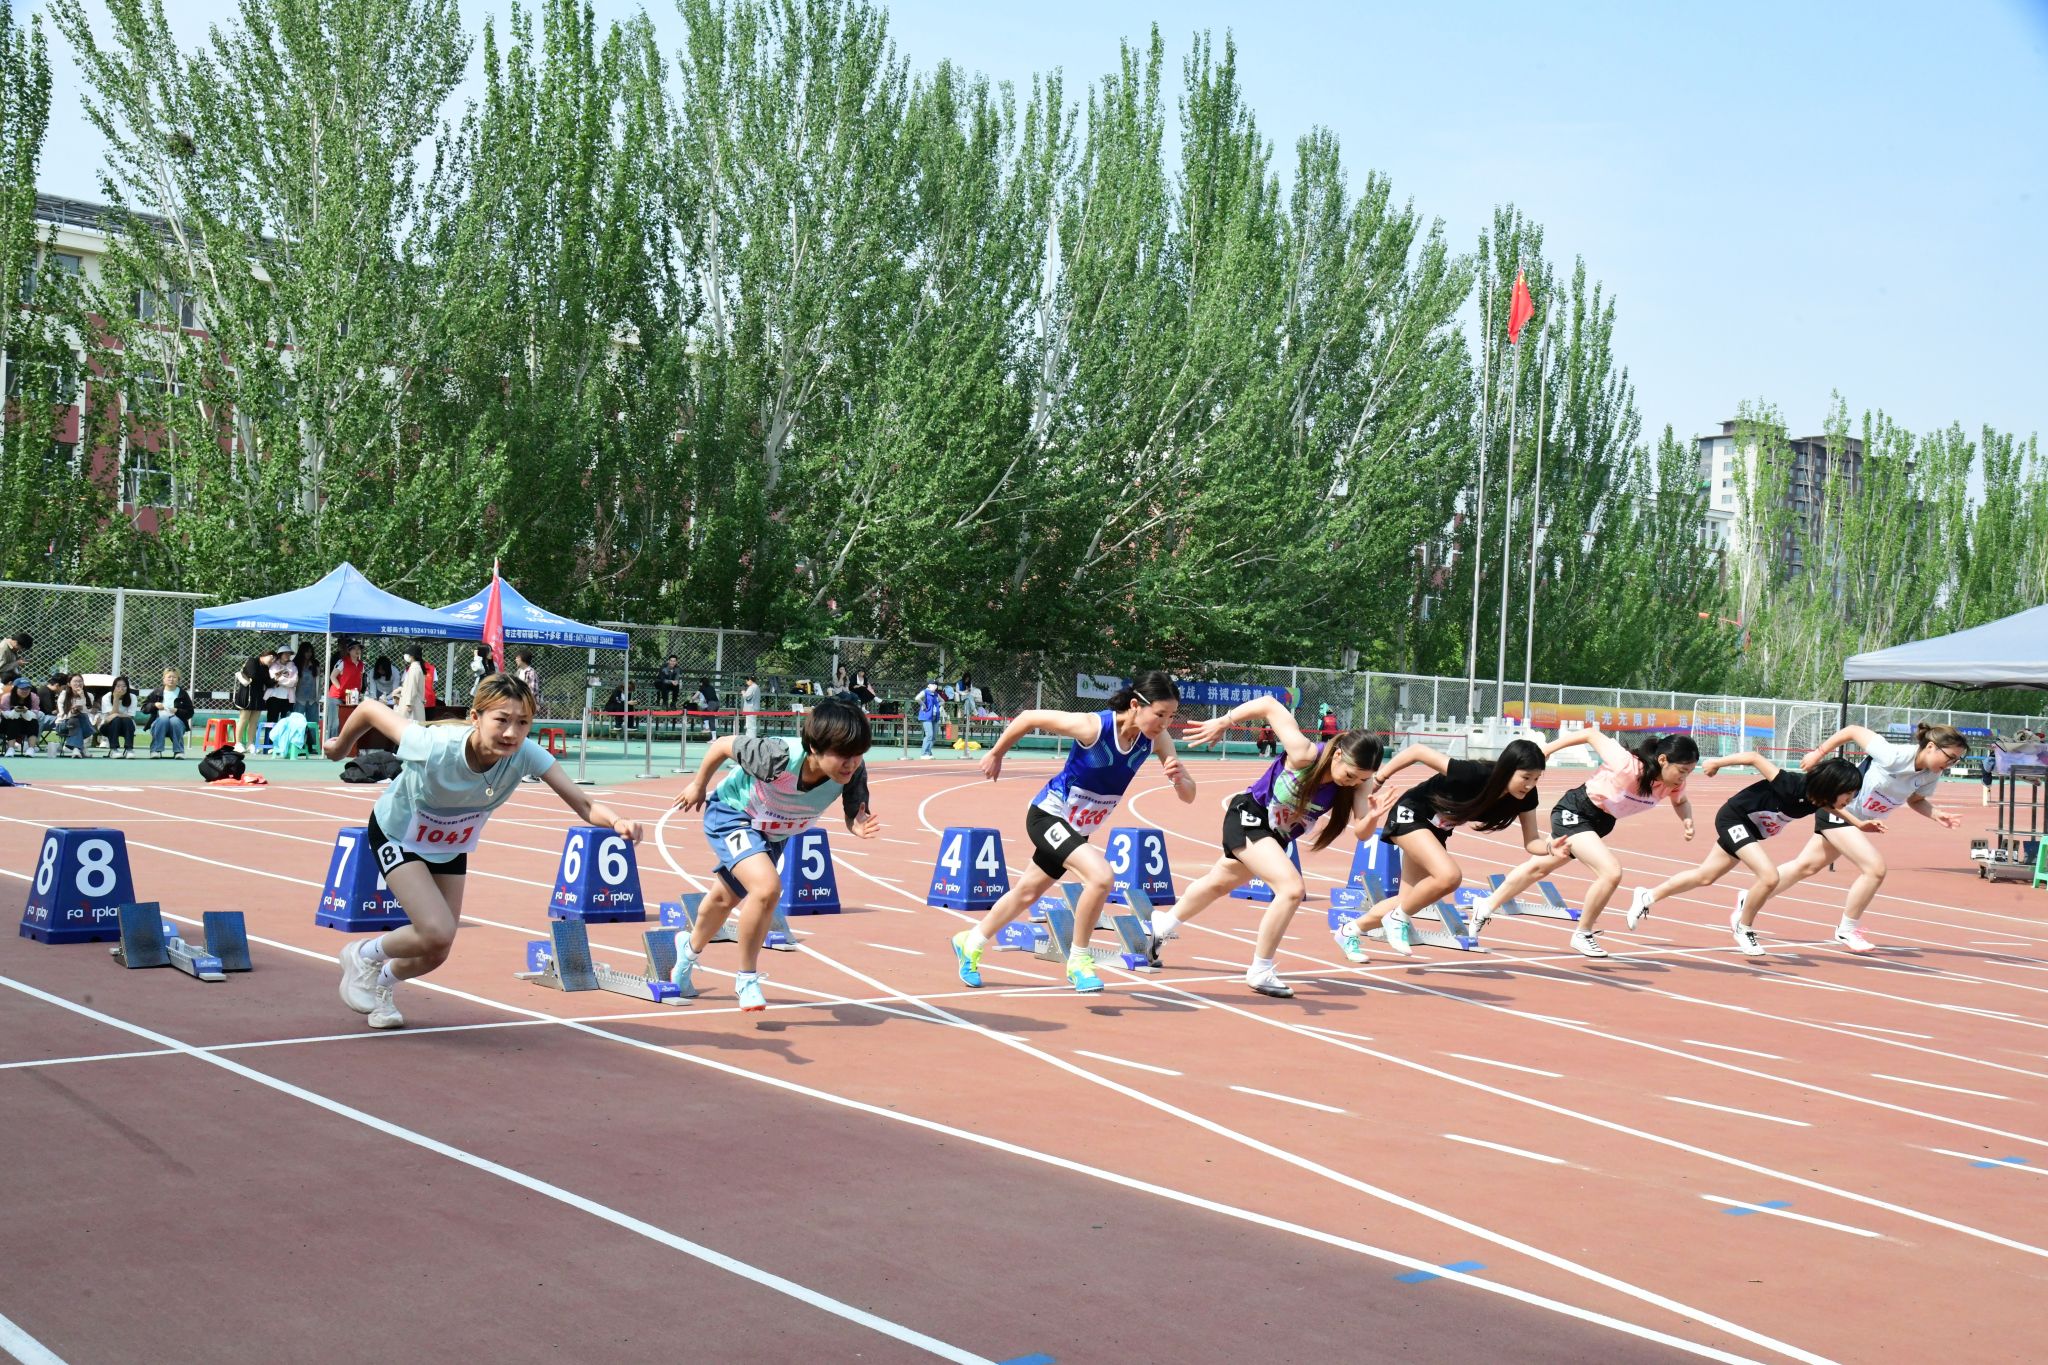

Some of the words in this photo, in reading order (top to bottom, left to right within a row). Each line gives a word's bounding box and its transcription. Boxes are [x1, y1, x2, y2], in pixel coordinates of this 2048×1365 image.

[1400, 809, 1410, 820] 4
[334, 836, 355, 888] 7
[382, 846, 396, 865] 8
[564, 835, 583, 883] 6
[598, 836, 628, 885] 6
[730, 833, 742, 850] 7
[802, 835, 825, 880] 5
[941, 834, 962, 876] 4
[976, 836, 999, 877] 4
[1110, 834, 1131, 874] 3
[1145, 835, 1163, 875] 3
[1364, 834, 1379, 869] 1
[37, 837, 58, 895] 8
[76, 839, 116, 897] 8
[67, 903, 119, 923] fairpla
